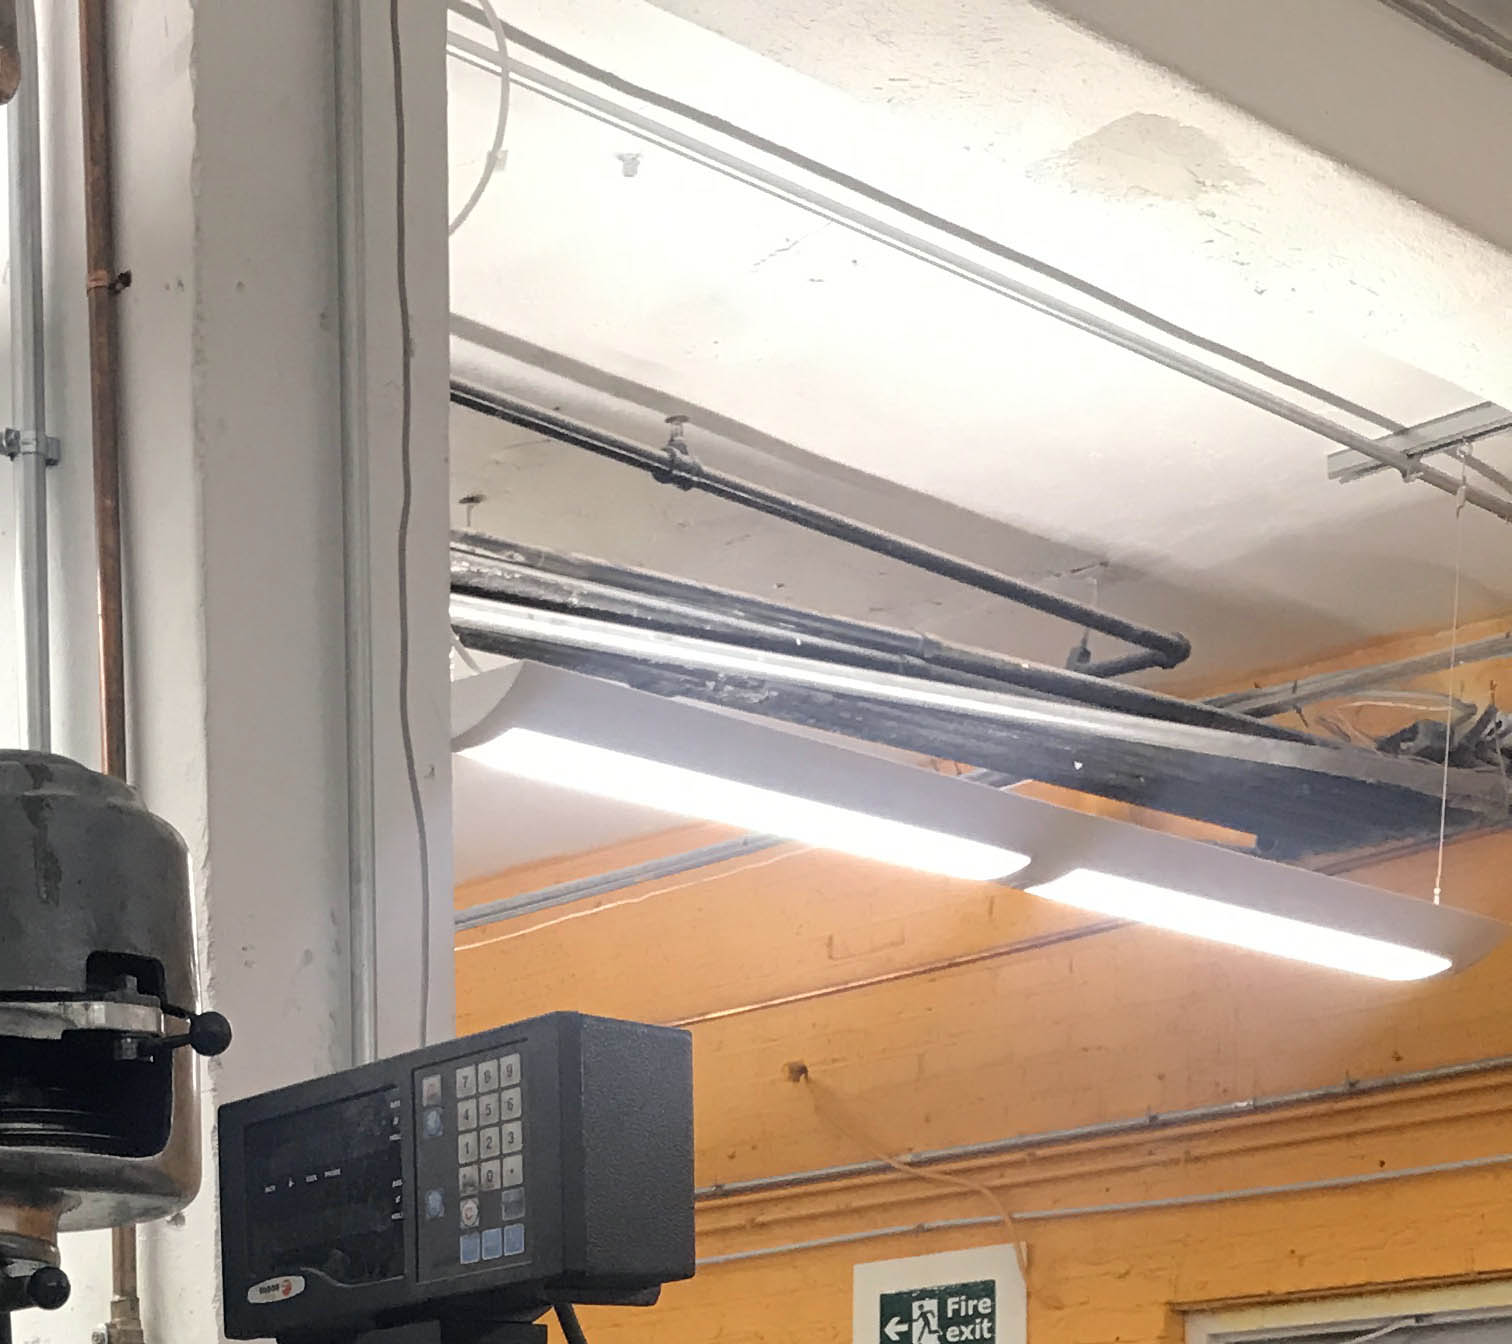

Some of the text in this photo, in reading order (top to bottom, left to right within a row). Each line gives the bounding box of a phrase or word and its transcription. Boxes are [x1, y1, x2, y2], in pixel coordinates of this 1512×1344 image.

[462, 1076, 469, 1089] 7
[463, 1108, 469, 1121] 4
[485, 1104, 492, 1116] 5
[464, 1131, 514, 1155] 1 2 3
[947, 1296, 992, 1318] Fire
[946, 1318, 993, 1342] exit
